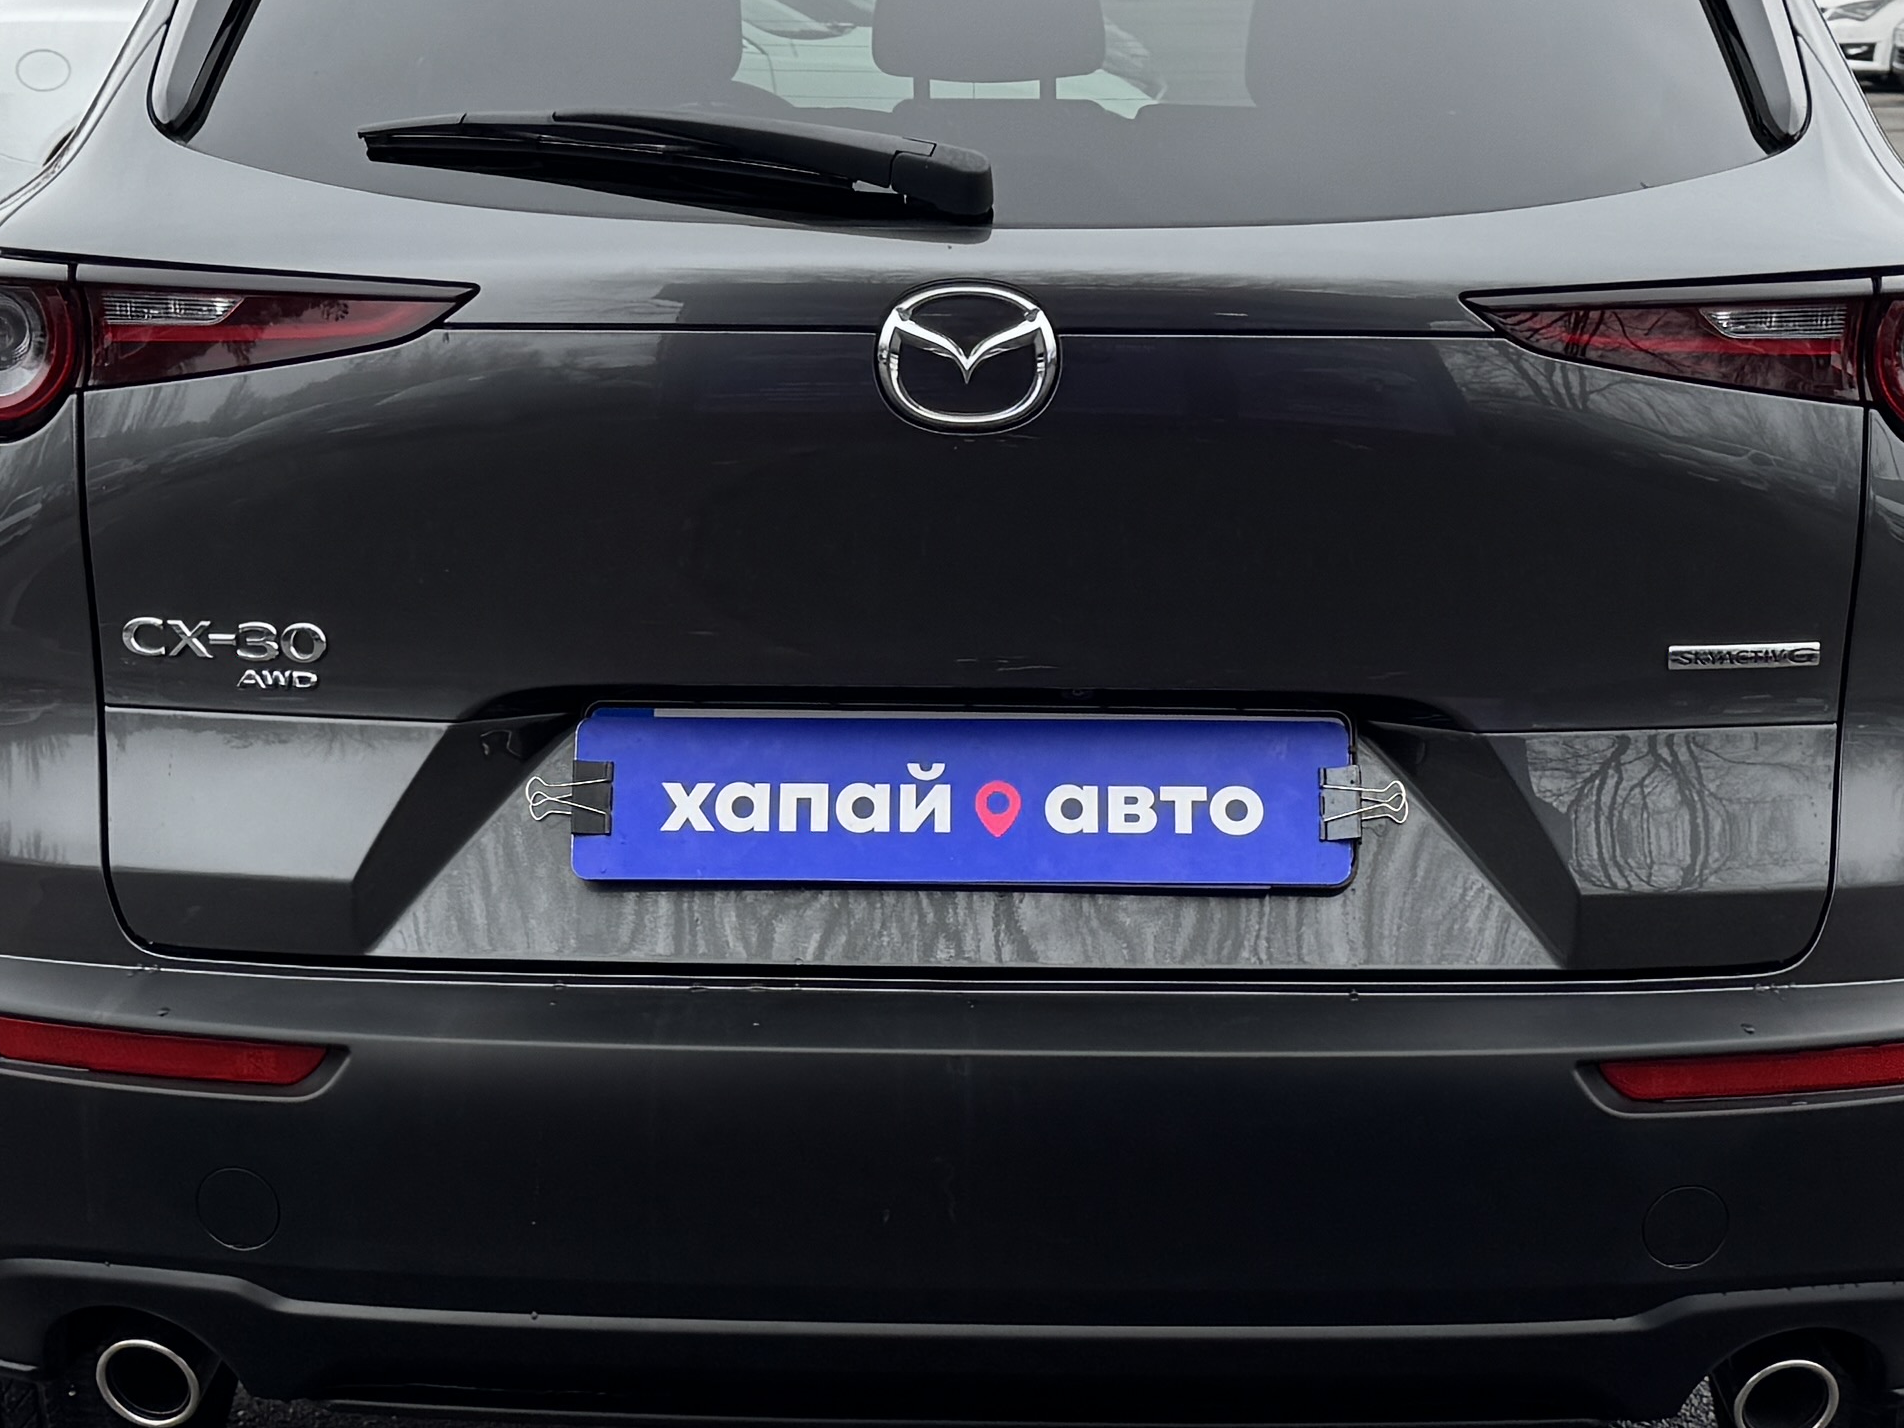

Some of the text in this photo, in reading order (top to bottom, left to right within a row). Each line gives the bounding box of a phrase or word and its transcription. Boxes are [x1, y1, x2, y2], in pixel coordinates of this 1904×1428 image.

[122, 616, 327, 664] CX-30
[236, 669, 318, 690] AWD
[660, 761, 1266, 836] хапай авто
